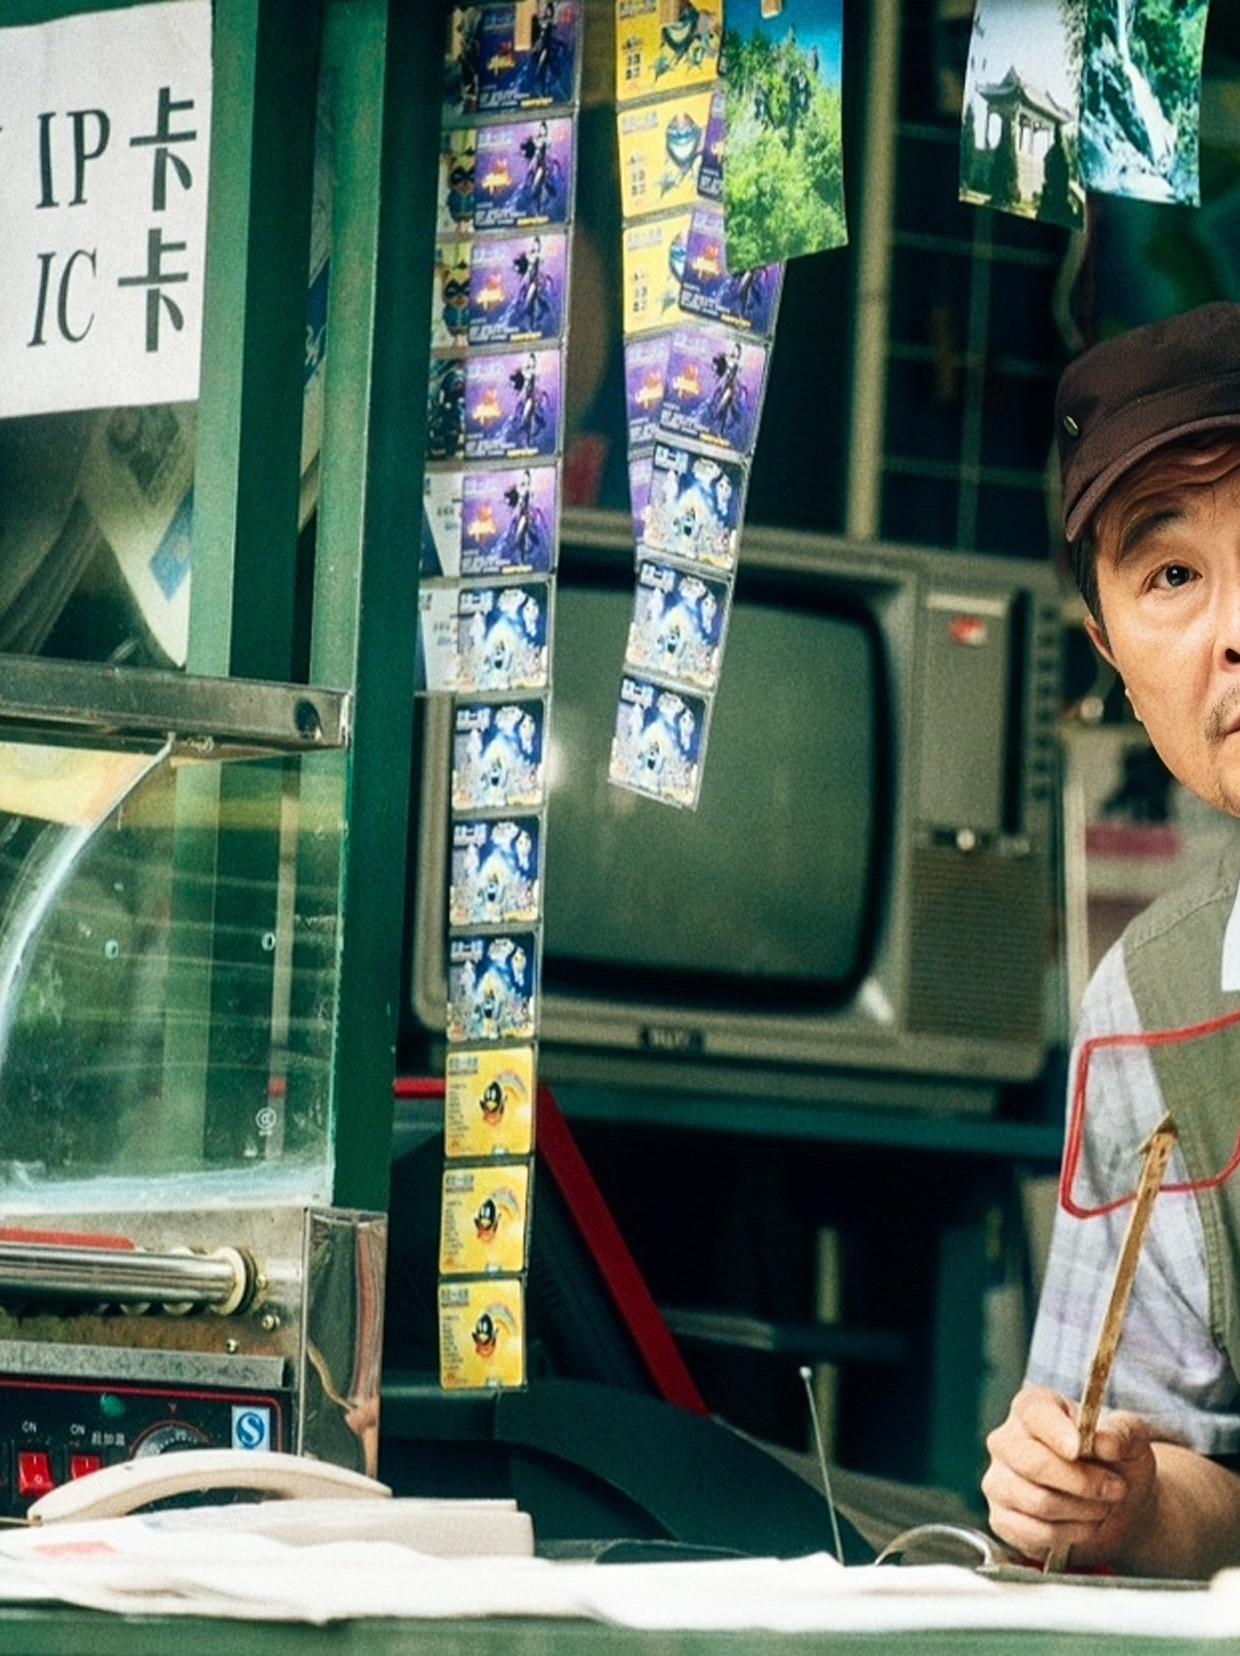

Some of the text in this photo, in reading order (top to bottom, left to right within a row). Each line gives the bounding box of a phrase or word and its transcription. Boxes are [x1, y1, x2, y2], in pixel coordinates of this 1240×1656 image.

[35, 86, 197, 212] IP卡
[27, 227, 189, 353] IC卡
[69, 1422, 86, 1437] ON
